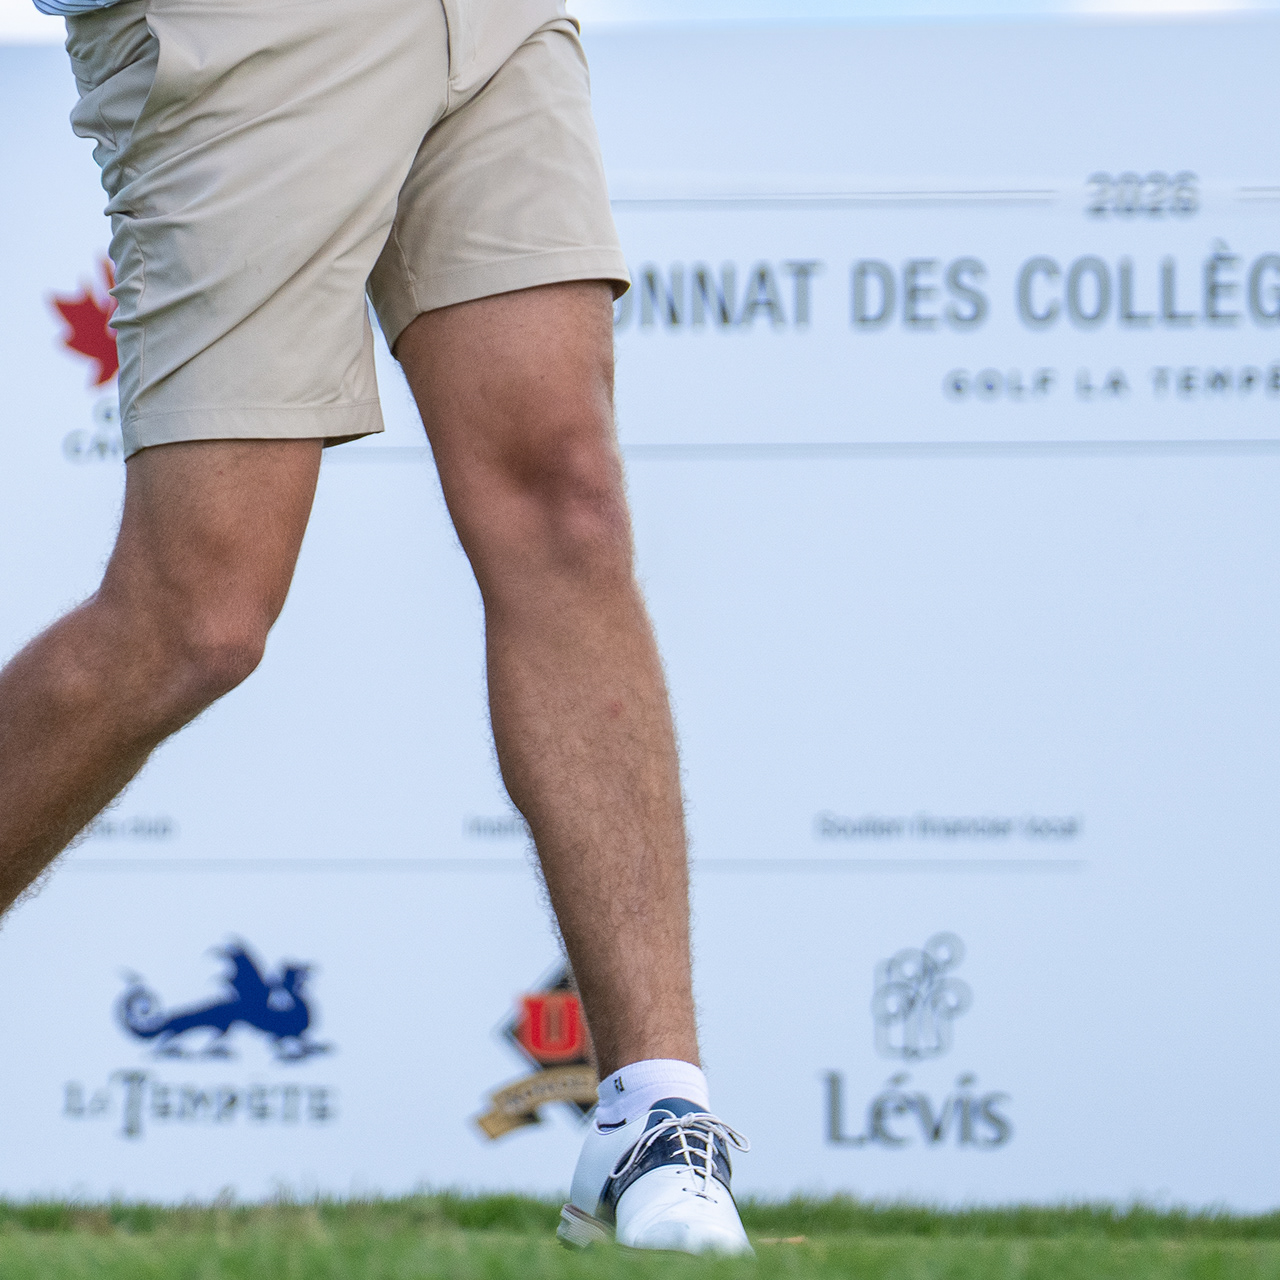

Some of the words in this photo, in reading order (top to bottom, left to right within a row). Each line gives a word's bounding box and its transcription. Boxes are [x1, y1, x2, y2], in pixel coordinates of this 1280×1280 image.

[1085, 171, 1200, 220] 2026
[849, 256, 989, 330] DES
[941, 366, 1057, 404] GOLF
[1074, 366, 1131, 404] LA
[820, 1071, 1014, 1150] Lévis
